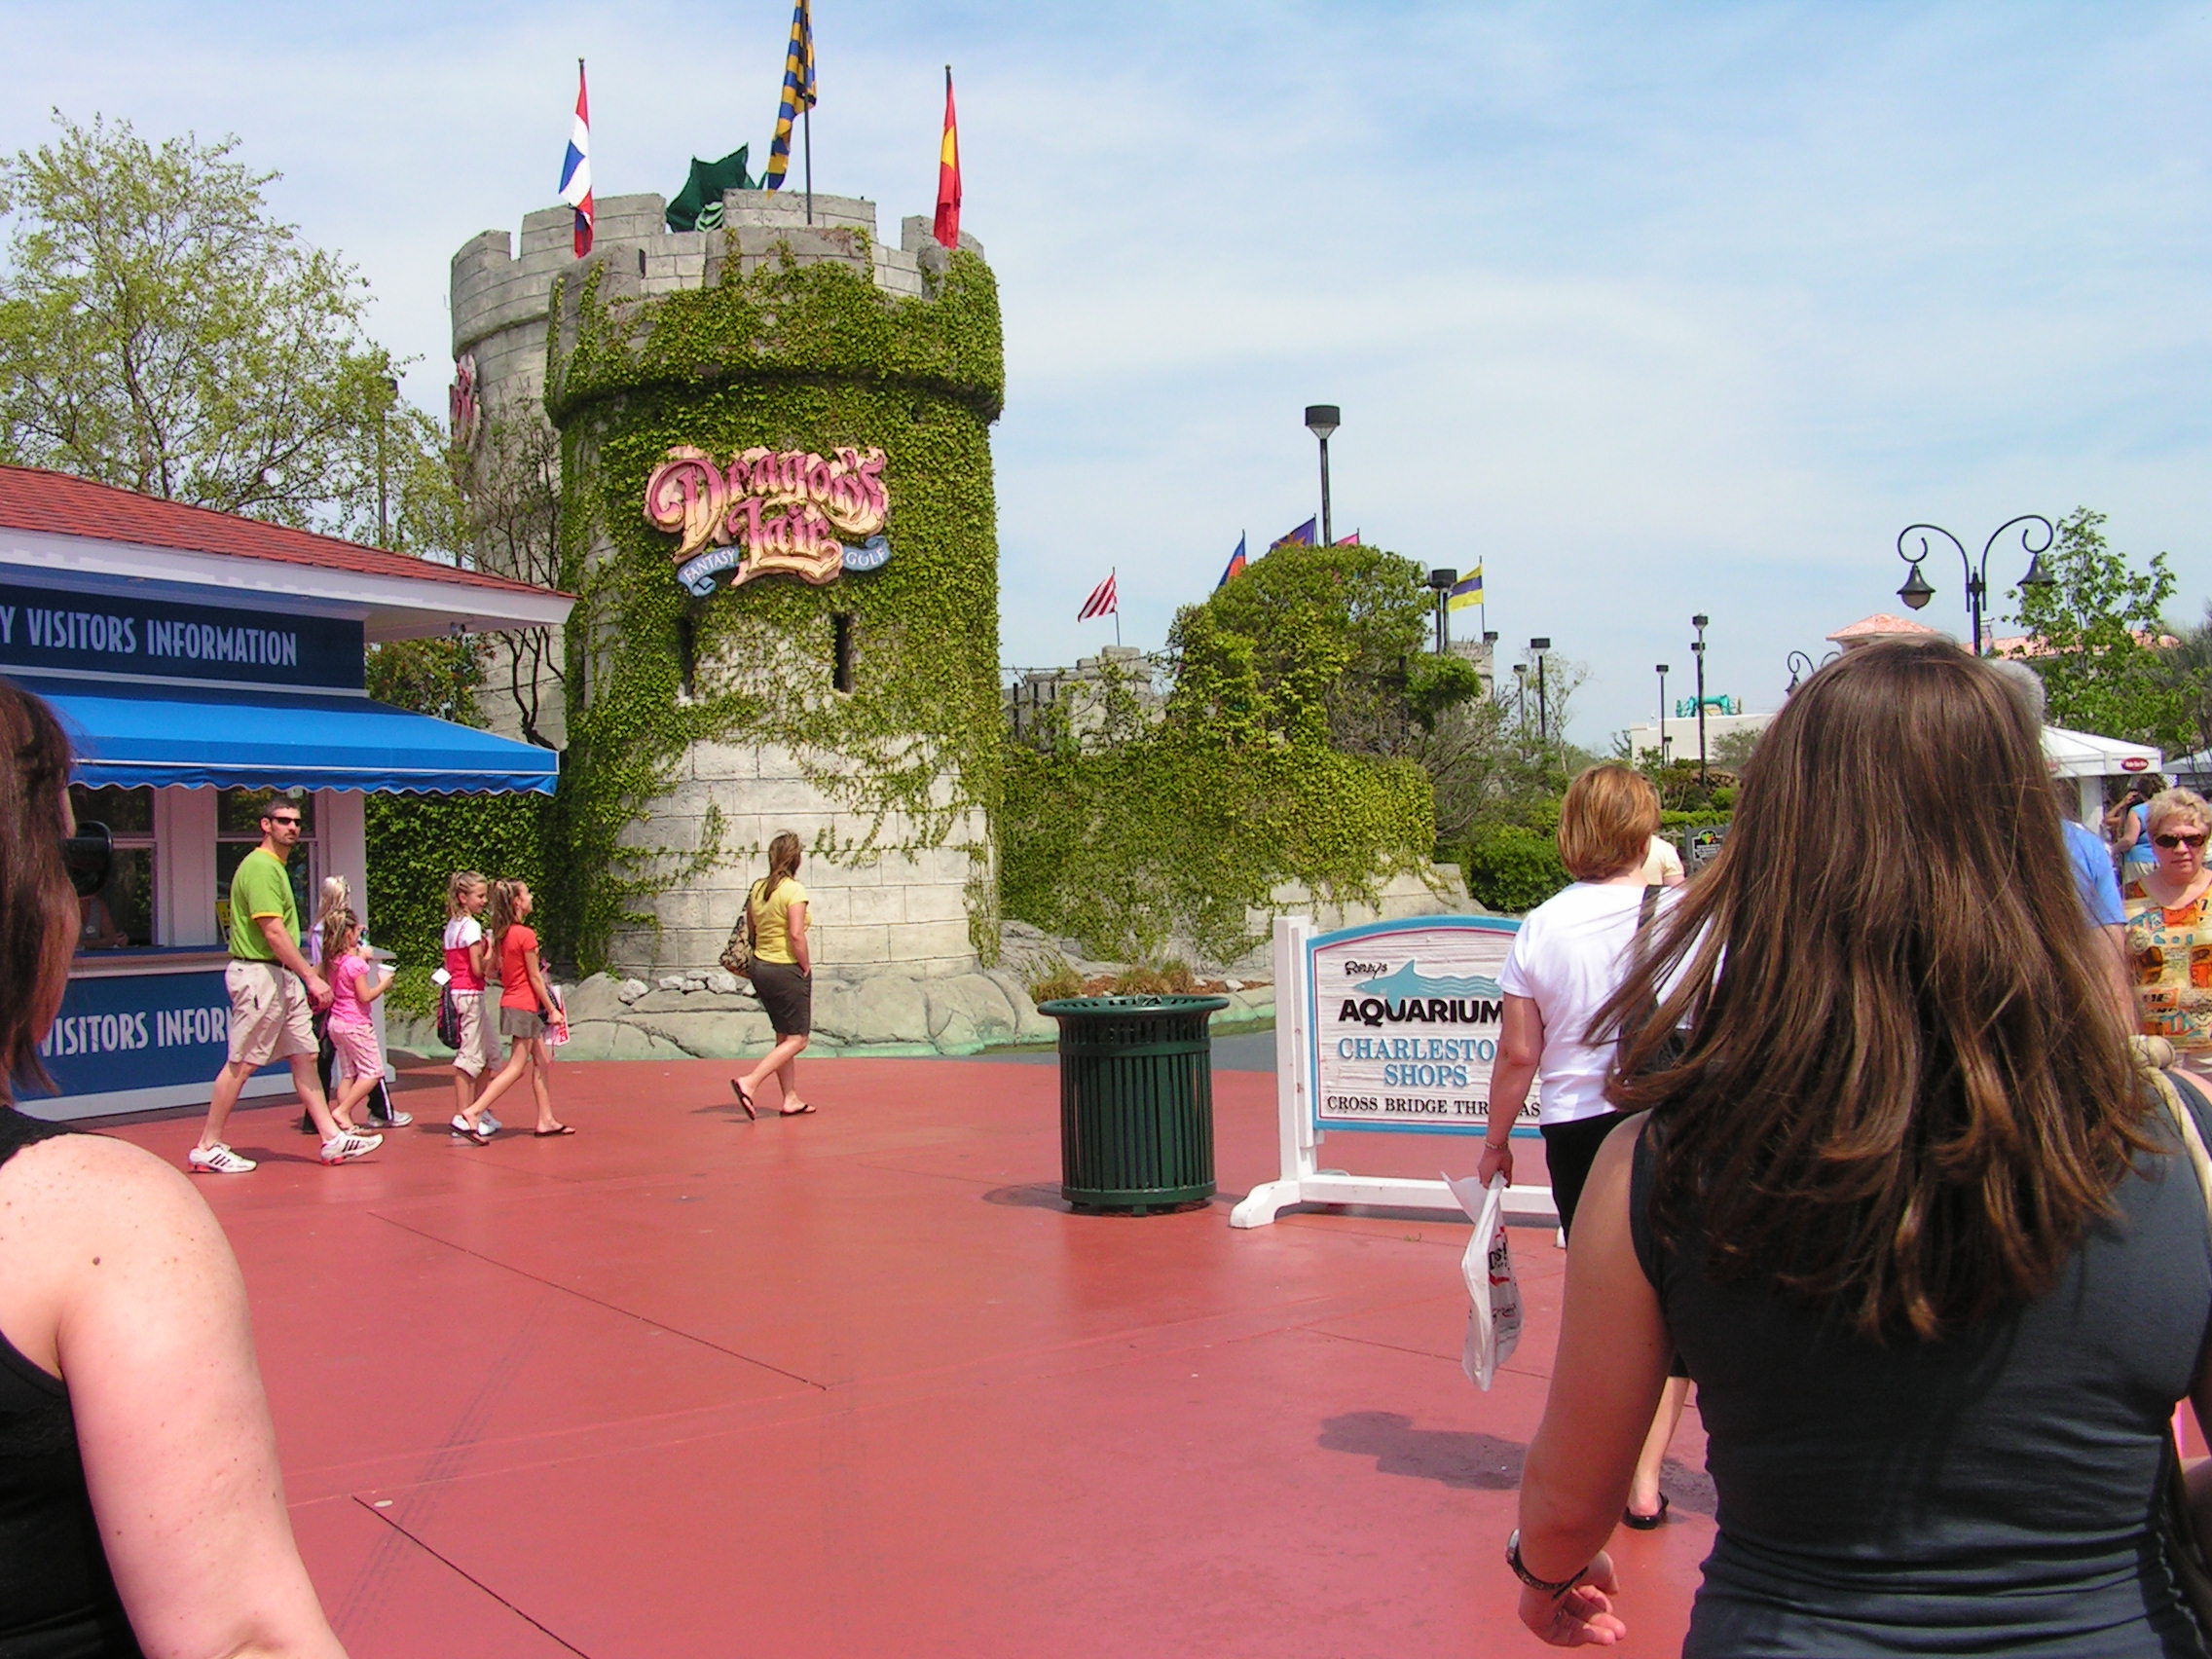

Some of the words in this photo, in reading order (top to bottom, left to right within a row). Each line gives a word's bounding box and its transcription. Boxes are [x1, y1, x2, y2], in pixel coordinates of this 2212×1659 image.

[683, 548, 736, 583] FANTASY
[845, 548, 888, 567] GOLF
[26, 608, 136, 654] VISITORS
[147, 619, 297, 666] INFORMATION
[1339, 998, 1504, 1027] AQUARIUM
[1339, 1038, 1496, 1061] CHARLESTO
[1384, 1063, 1468, 1087] SHOPS
[1327, 1095, 1379, 1111] CROSS
[1384, 1097, 1448, 1114] BRIDGE
[1454, 1100, 1490, 1115] THR
